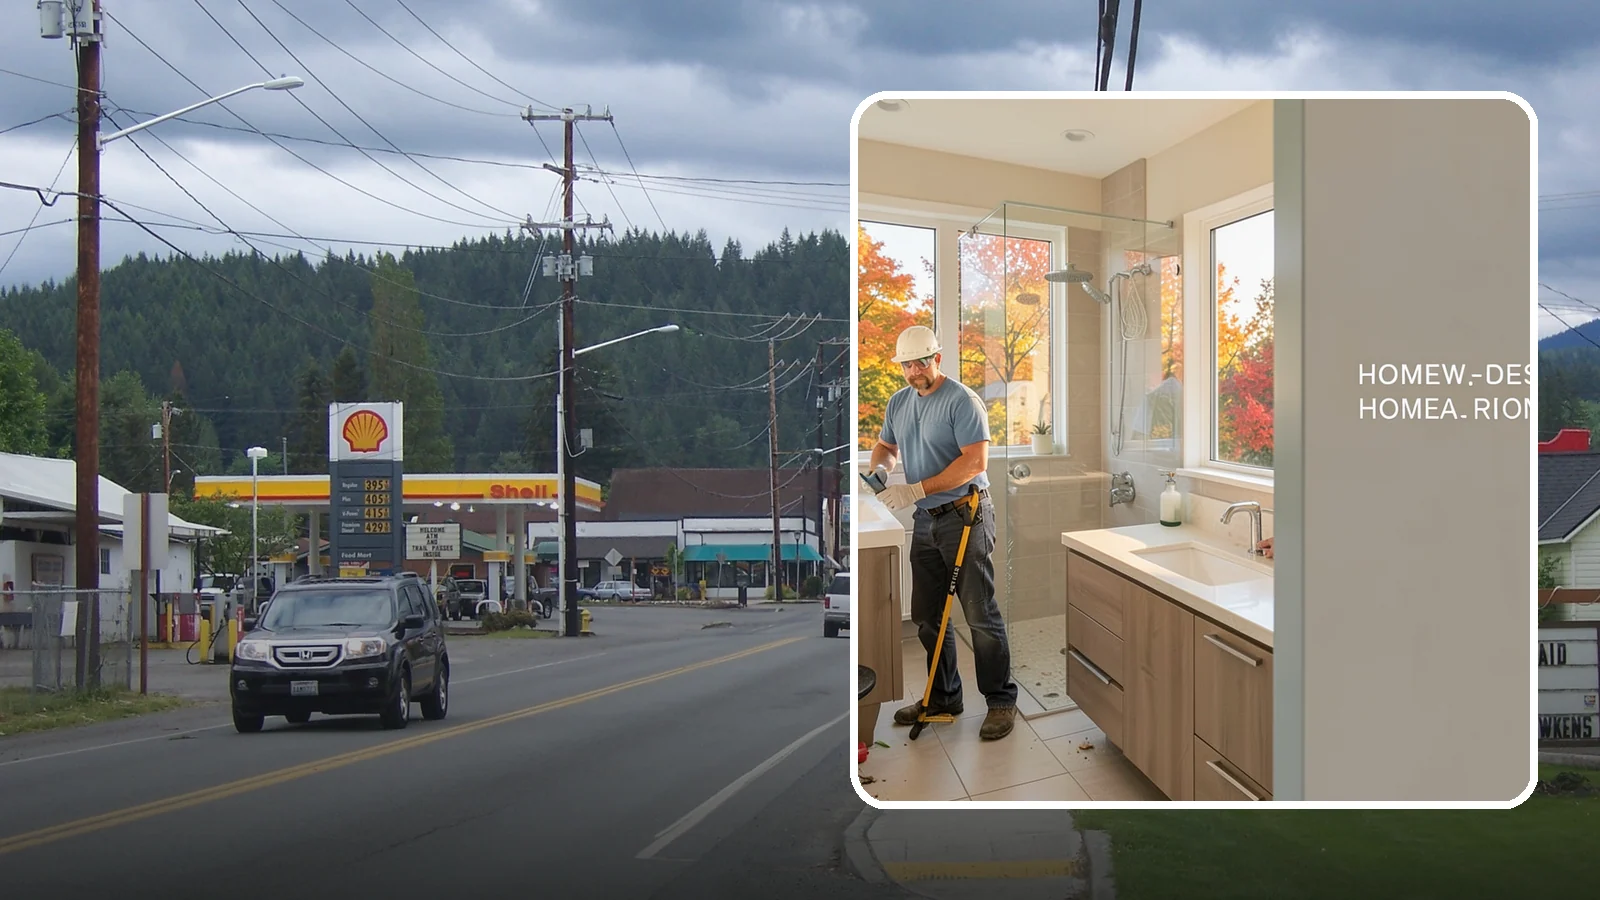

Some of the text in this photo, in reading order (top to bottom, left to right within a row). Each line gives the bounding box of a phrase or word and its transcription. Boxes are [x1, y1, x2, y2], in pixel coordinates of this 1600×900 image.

[366, 480, 383, 490] 395
[490, 484, 547, 499] Shell
[366, 494, 383, 504] 405
[366, 508, 383, 518] 415
[366, 522, 383, 532] 429
